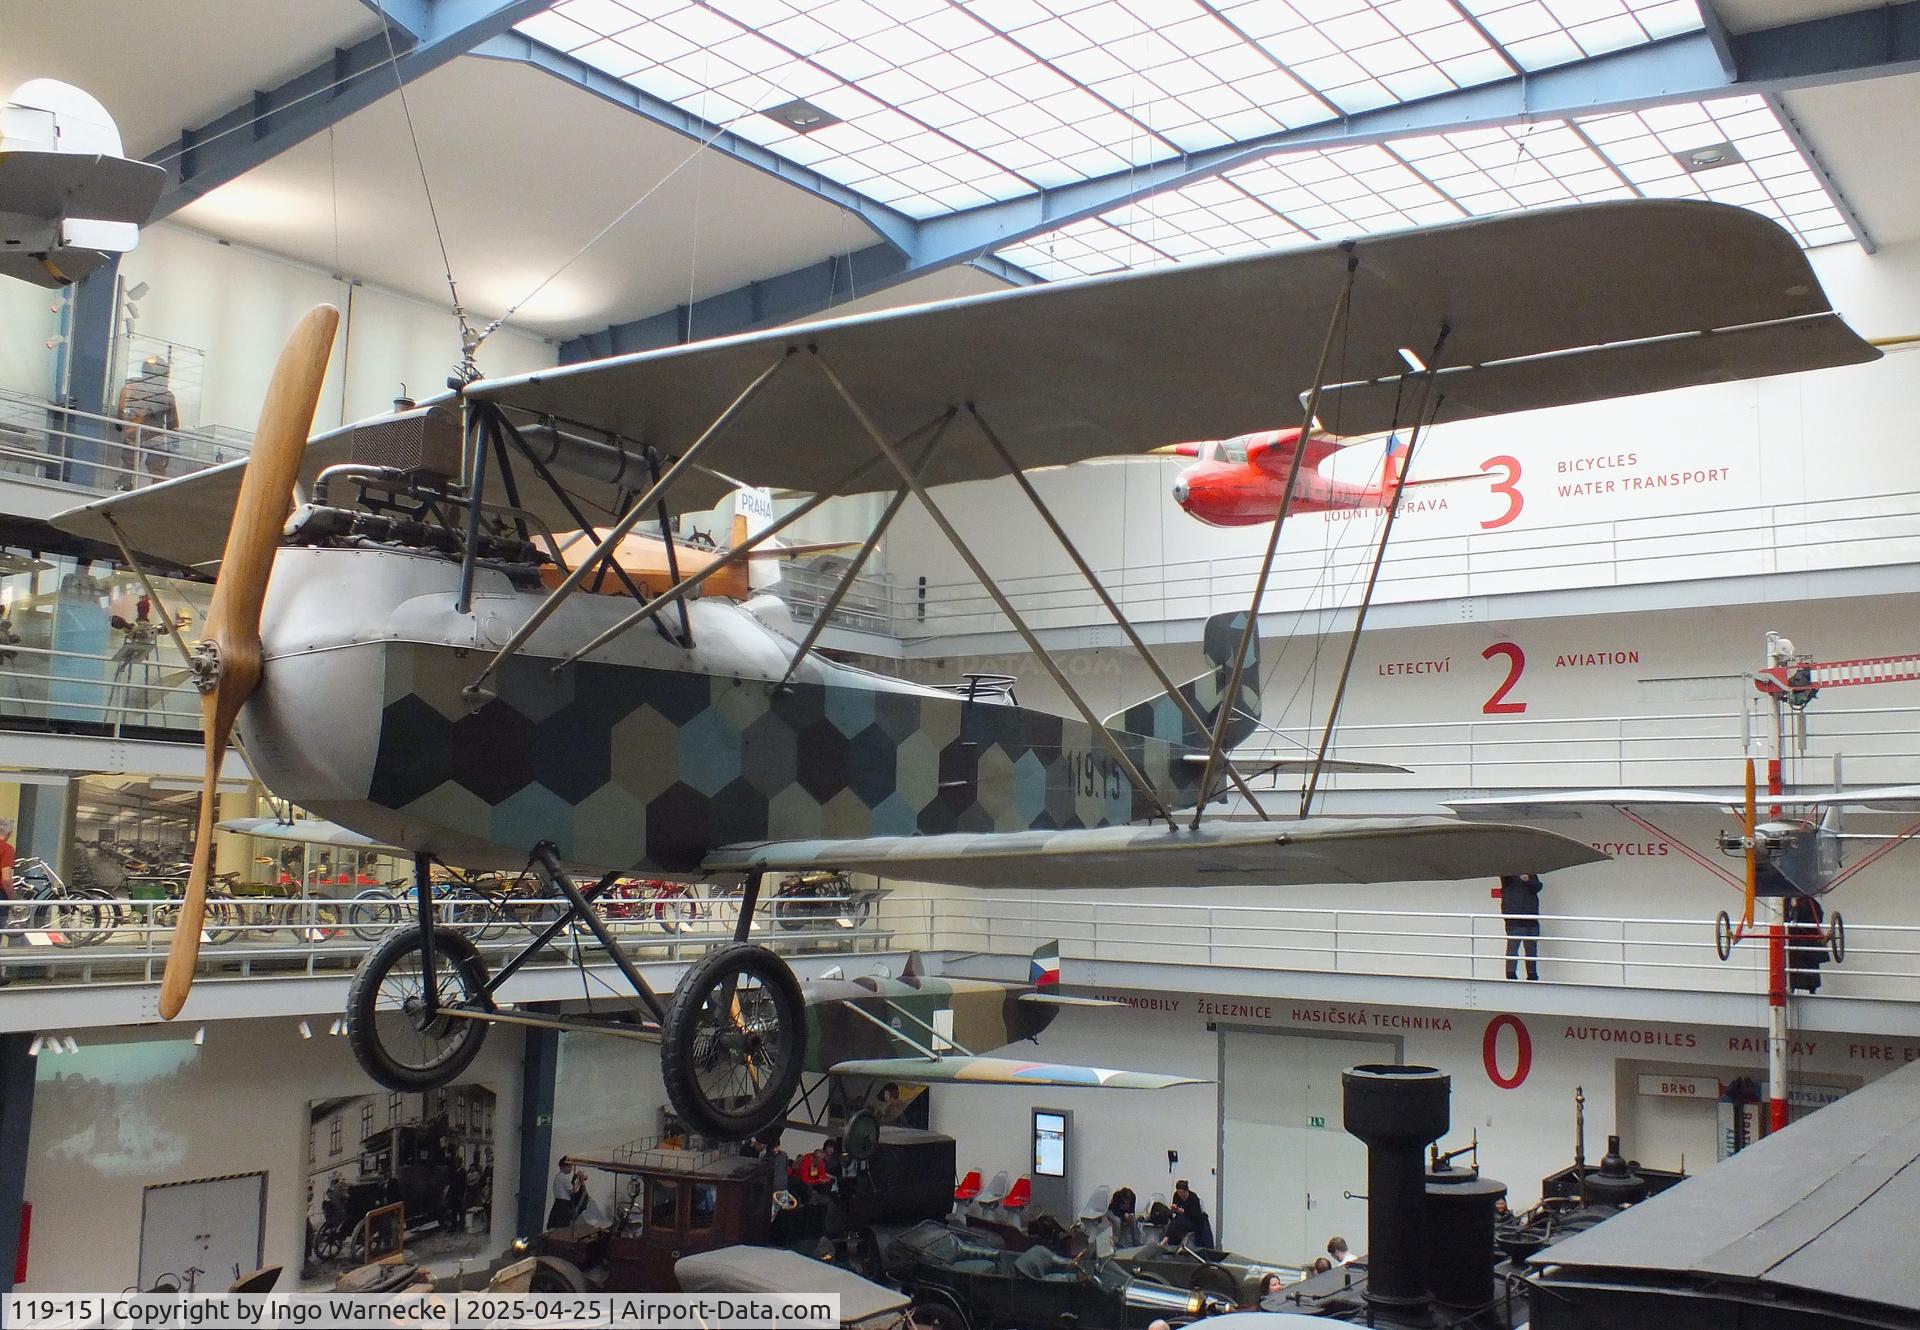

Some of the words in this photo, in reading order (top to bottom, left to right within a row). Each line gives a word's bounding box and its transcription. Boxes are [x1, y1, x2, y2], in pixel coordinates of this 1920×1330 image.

[1557, 453, 1638, 473] BICYCLES
[1479, 455, 1524, 529] 3
[1557, 479, 1616, 498] WATER
[1622, 467, 1730, 490] TRANSPORT
[741, 493, 772, 520] PRAHA
[1376, 497, 1449, 519] DPRAVA
[1378, 656, 1451, 676] LETECTVÍ
[1555, 650, 1640, 668] AVIATION
[1481, 641, 1528, 714] 2
[1591, 842, 1669, 856] CYCLES
[1197, 999, 1272, 1018] ŽELEZNICE
[1291, 1006, 1367, 1026] HASIČSKÁ
[1372, 1013, 1453, 1031] TECHNIKA
[1564, 1026, 1697, 1048] AUTOMOBILES
[1728, 1037, 1817, 1056] RAILAY
[1849, 1044, 1894, 1061] FIRE
[1661, 1083, 1696, 1095] BRNO
